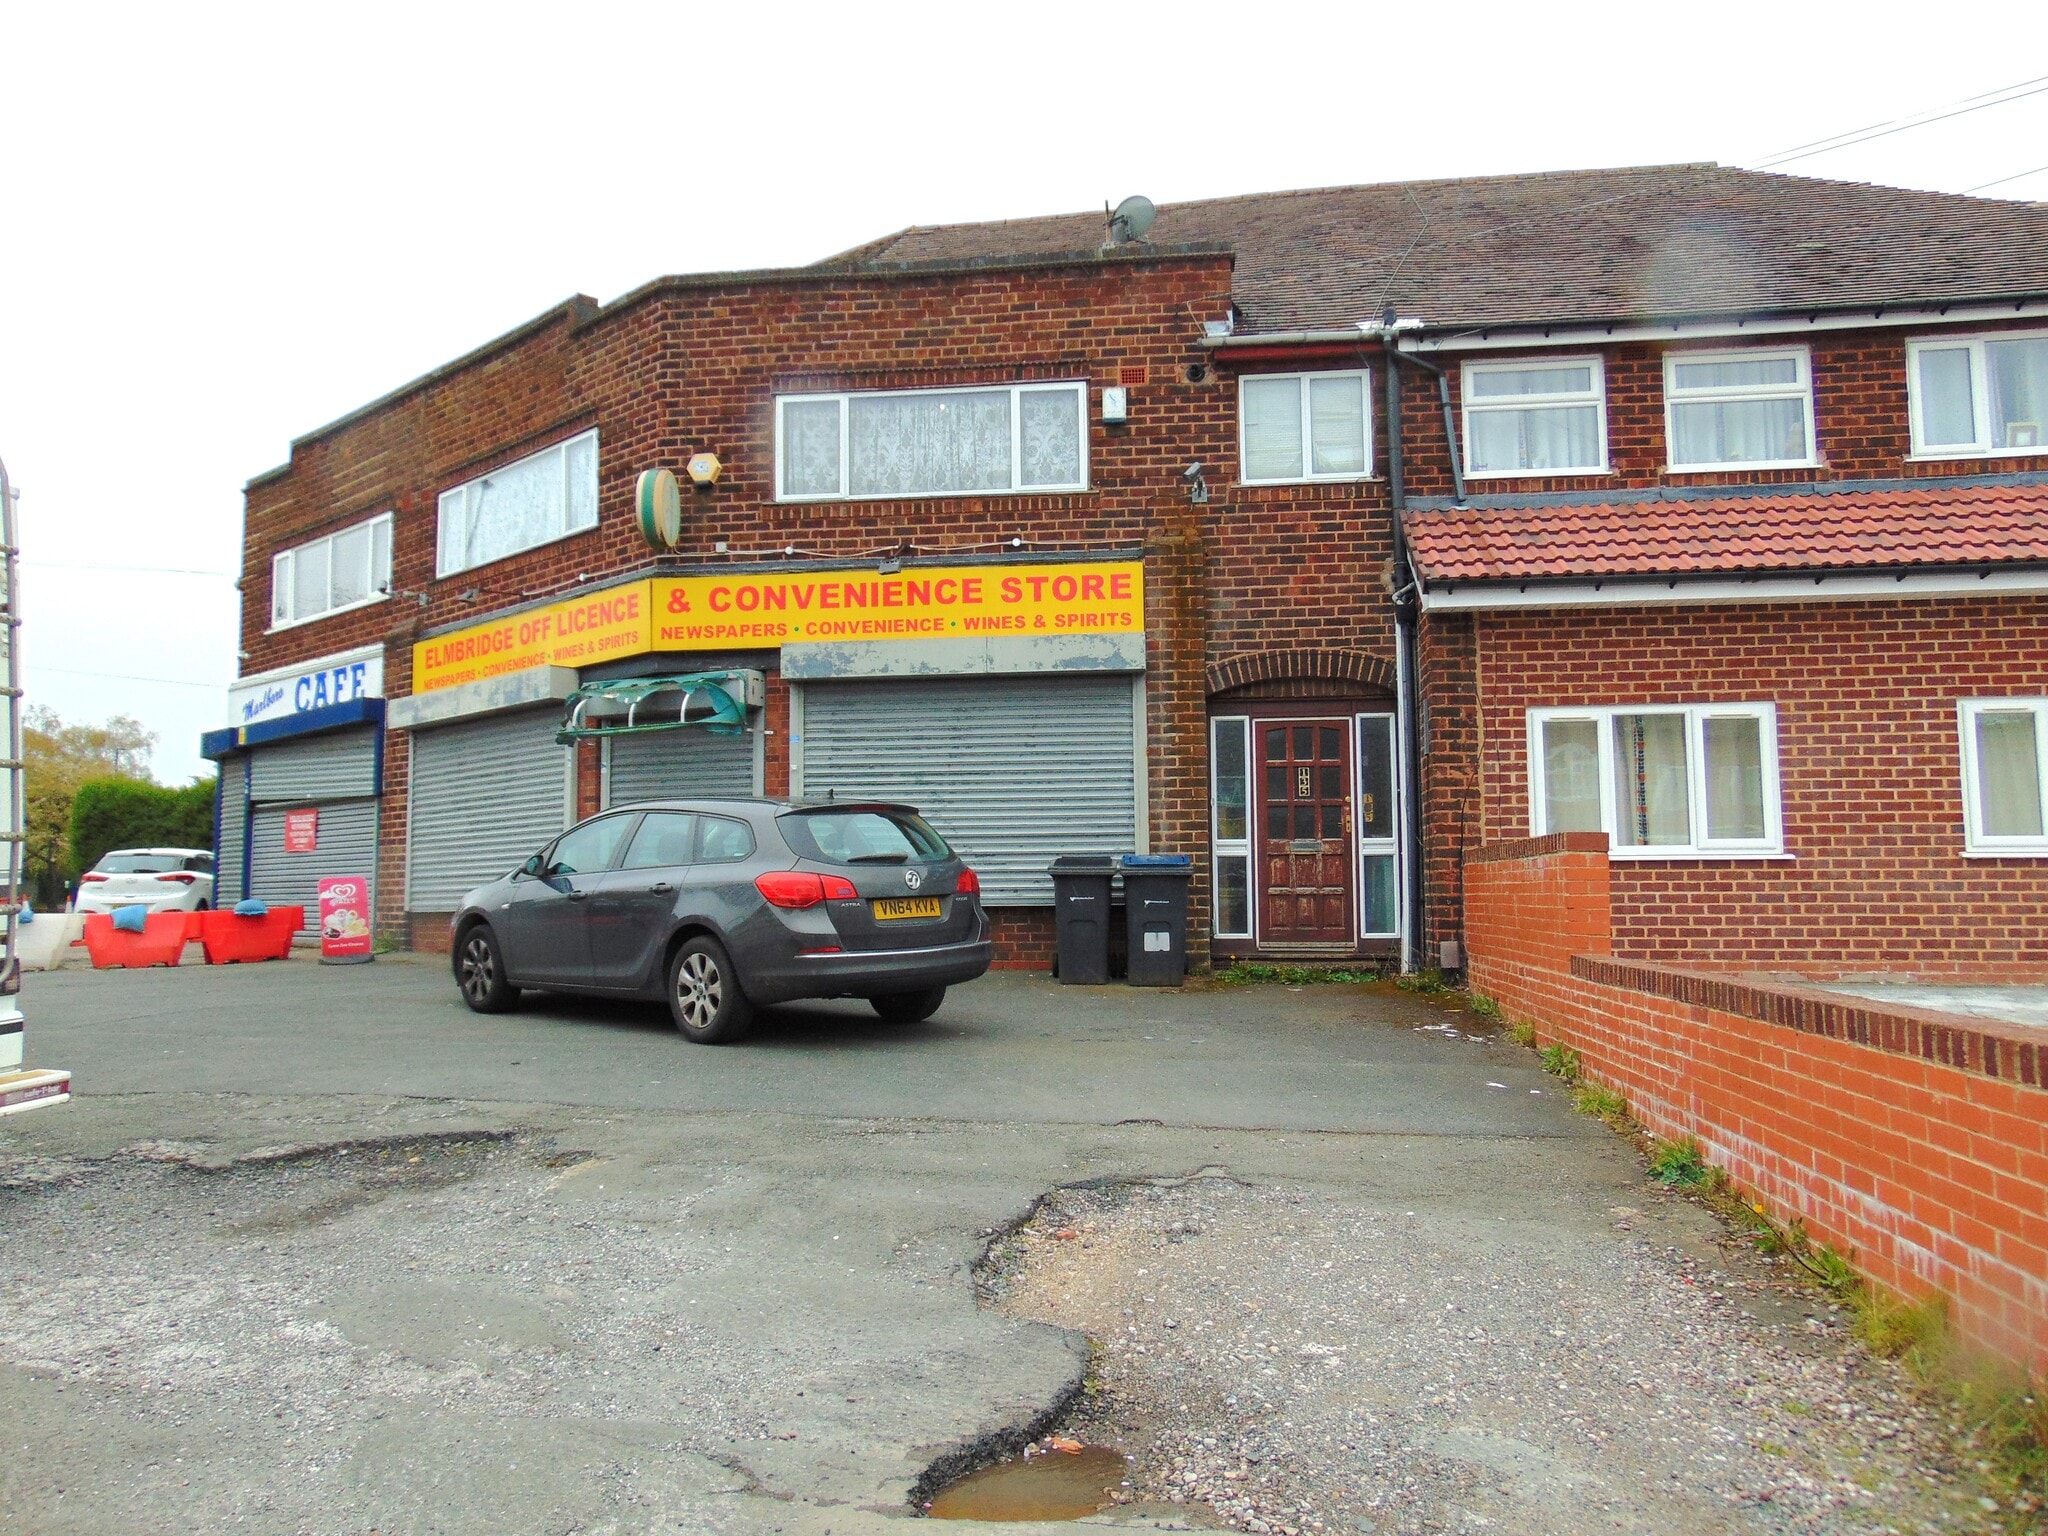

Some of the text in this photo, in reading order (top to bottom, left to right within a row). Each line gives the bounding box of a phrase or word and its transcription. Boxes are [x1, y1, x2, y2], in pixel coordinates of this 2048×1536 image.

[667, 573, 1133, 614] & CONVENIENCE STORE
[425, 593, 639, 670] ELMBRIDGE OFF LICENCE
[660, 612, 1133, 640] NEWSPAPERS CONVENIENCE WINES & SPIRITS
[424, 631, 639, 690] NEWSPAPERS CONVENIENCE WINES & SPIRITS
[295, 663, 366, 712] CAFE
[1300, 767, 1309, 796] 135
[879, 899, 936, 916] VN64 KVA
